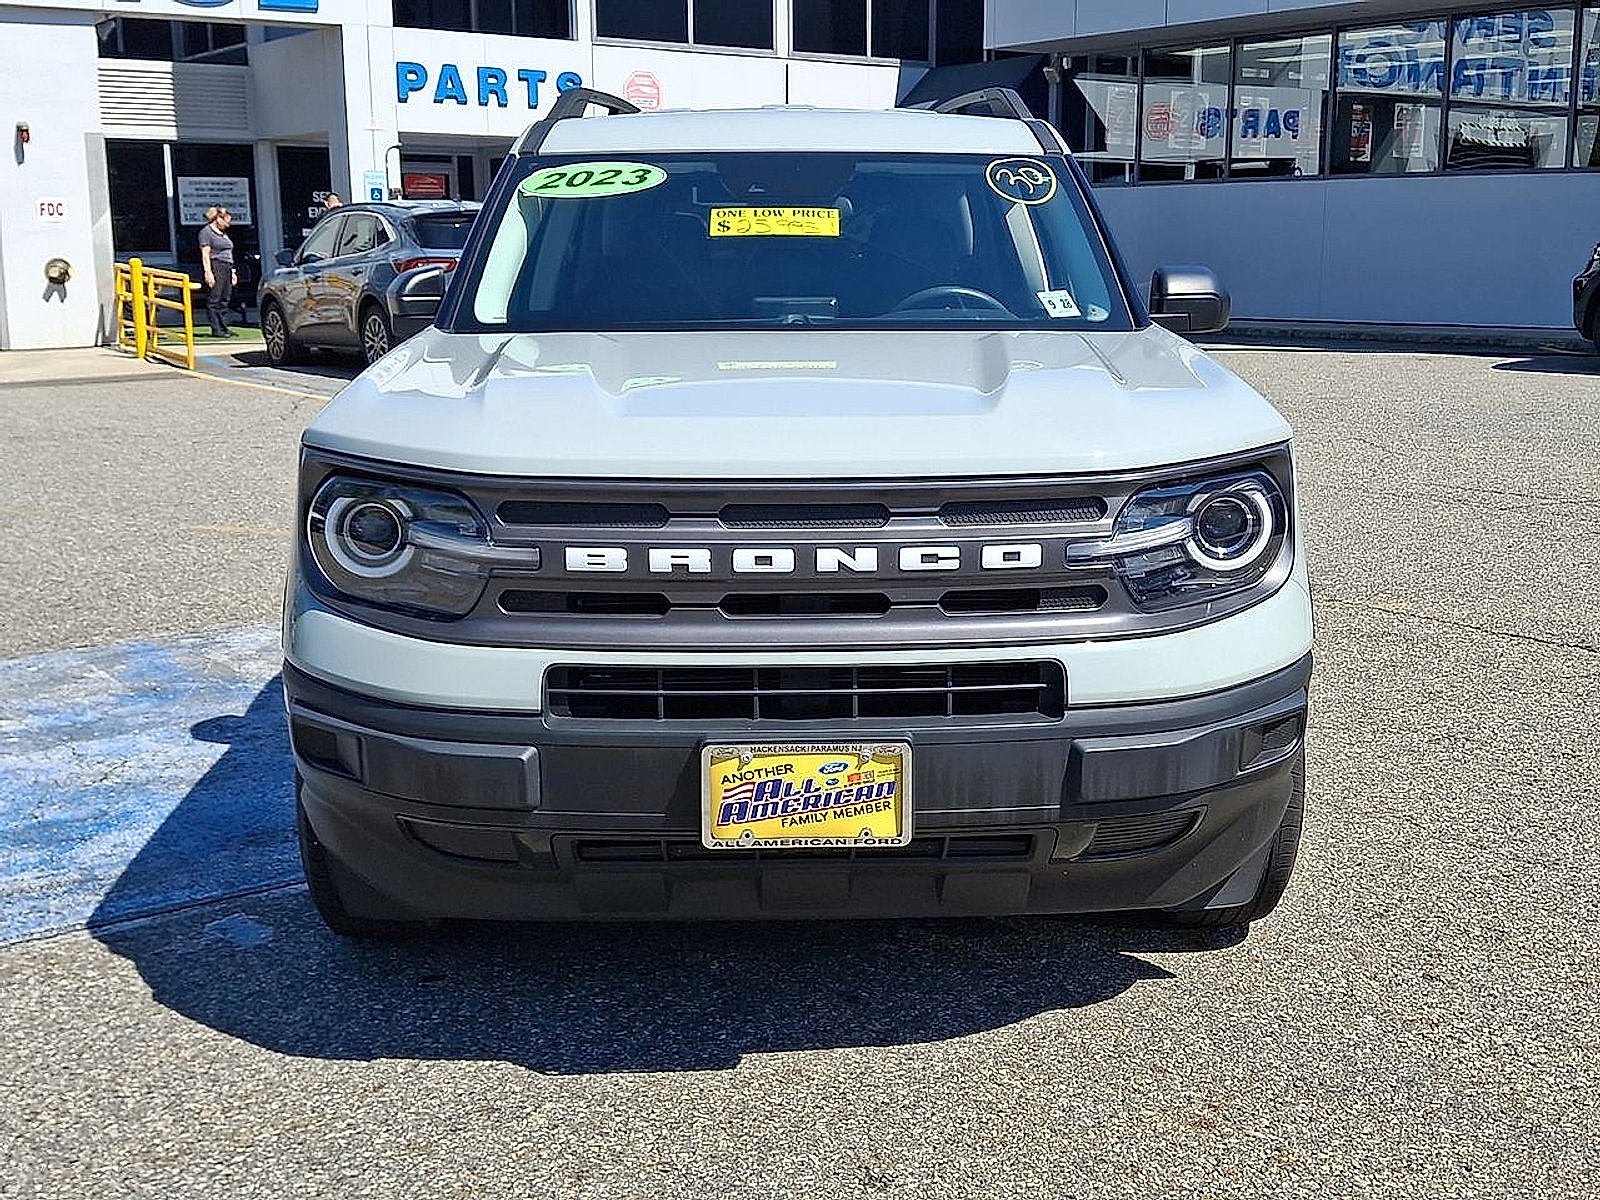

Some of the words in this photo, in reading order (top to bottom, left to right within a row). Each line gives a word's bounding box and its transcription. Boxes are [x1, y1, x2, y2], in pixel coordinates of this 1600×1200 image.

[396, 61, 582, 109] PARTS
[535, 168, 651, 190] 2023
[39, 202, 64, 217] FDC
[716, 210, 747, 218] ONE
[753, 209, 784, 218] LOW
[792, 209, 835, 219] PRICE
[565, 545, 1042, 573] BRONCO
[721, 764, 794, 784] ANOTHER
[753, 778, 821, 802] ALL
[720, 781, 896, 824] AMERICAN
[781, 812, 828, 828] FAMILY
[833, 801, 892, 820] MEMBER
[752, 838, 847, 846] AMERICAN
